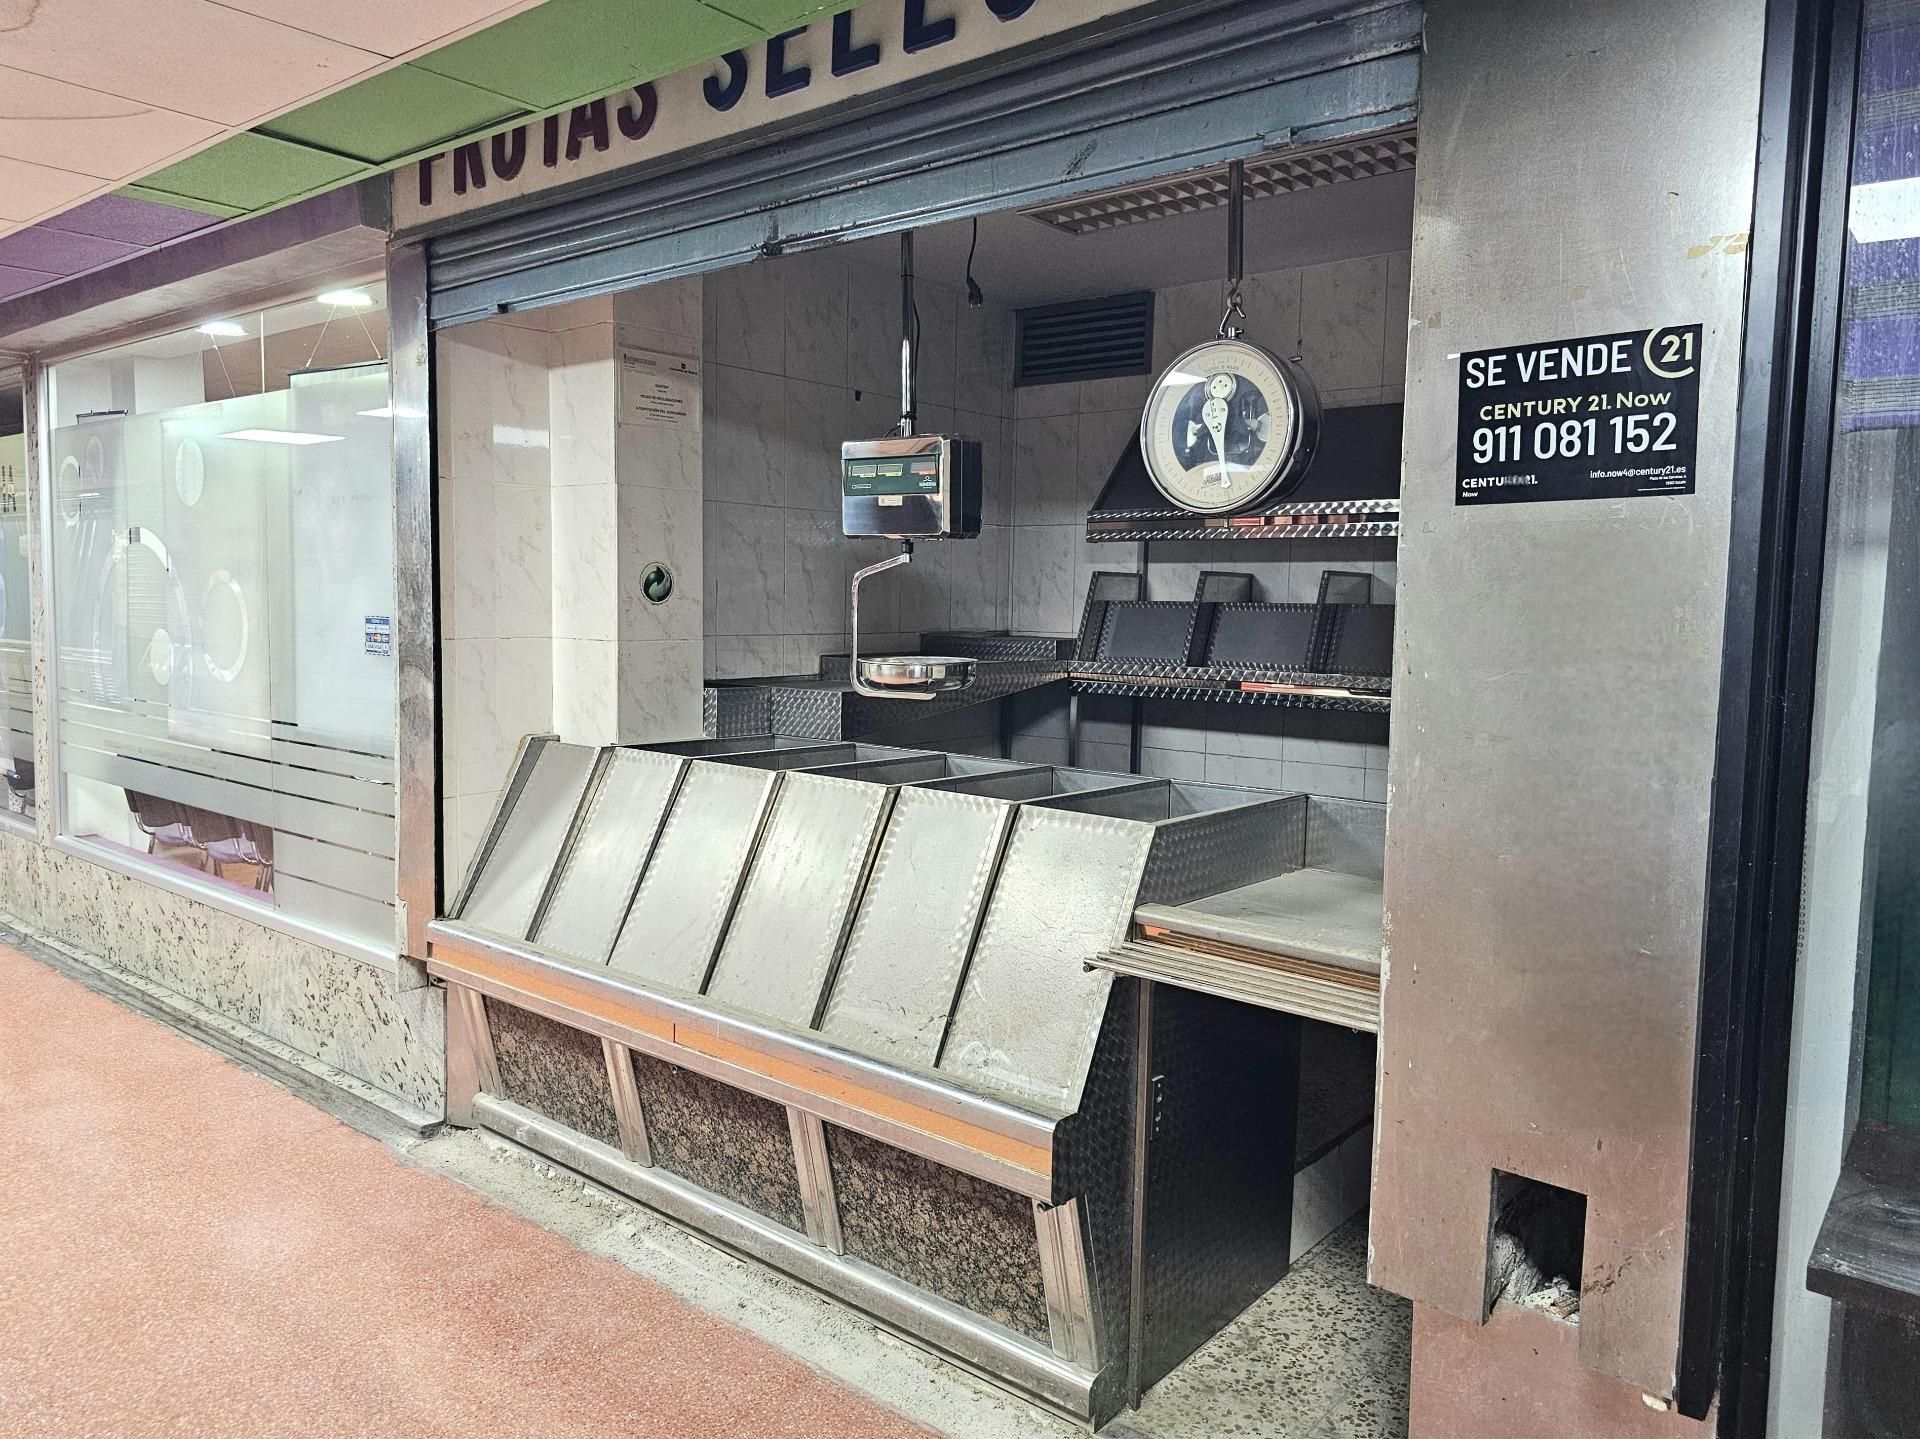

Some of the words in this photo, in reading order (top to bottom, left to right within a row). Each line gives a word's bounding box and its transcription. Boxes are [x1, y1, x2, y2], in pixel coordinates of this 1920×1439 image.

[1466, 354, 1507, 389] SE
[1516, 339, 1633, 383] VENDE
[1480, 396, 1582, 421] CENTURY
[1587, 393, 1612, 411] 21.
[1473, 425, 1521, 464] 911
[1534, 418, 1596, 460] 081
[1609, 412, 1677, 454] 152
[1590, 465, 1687, 479] info.now4@century21.es
